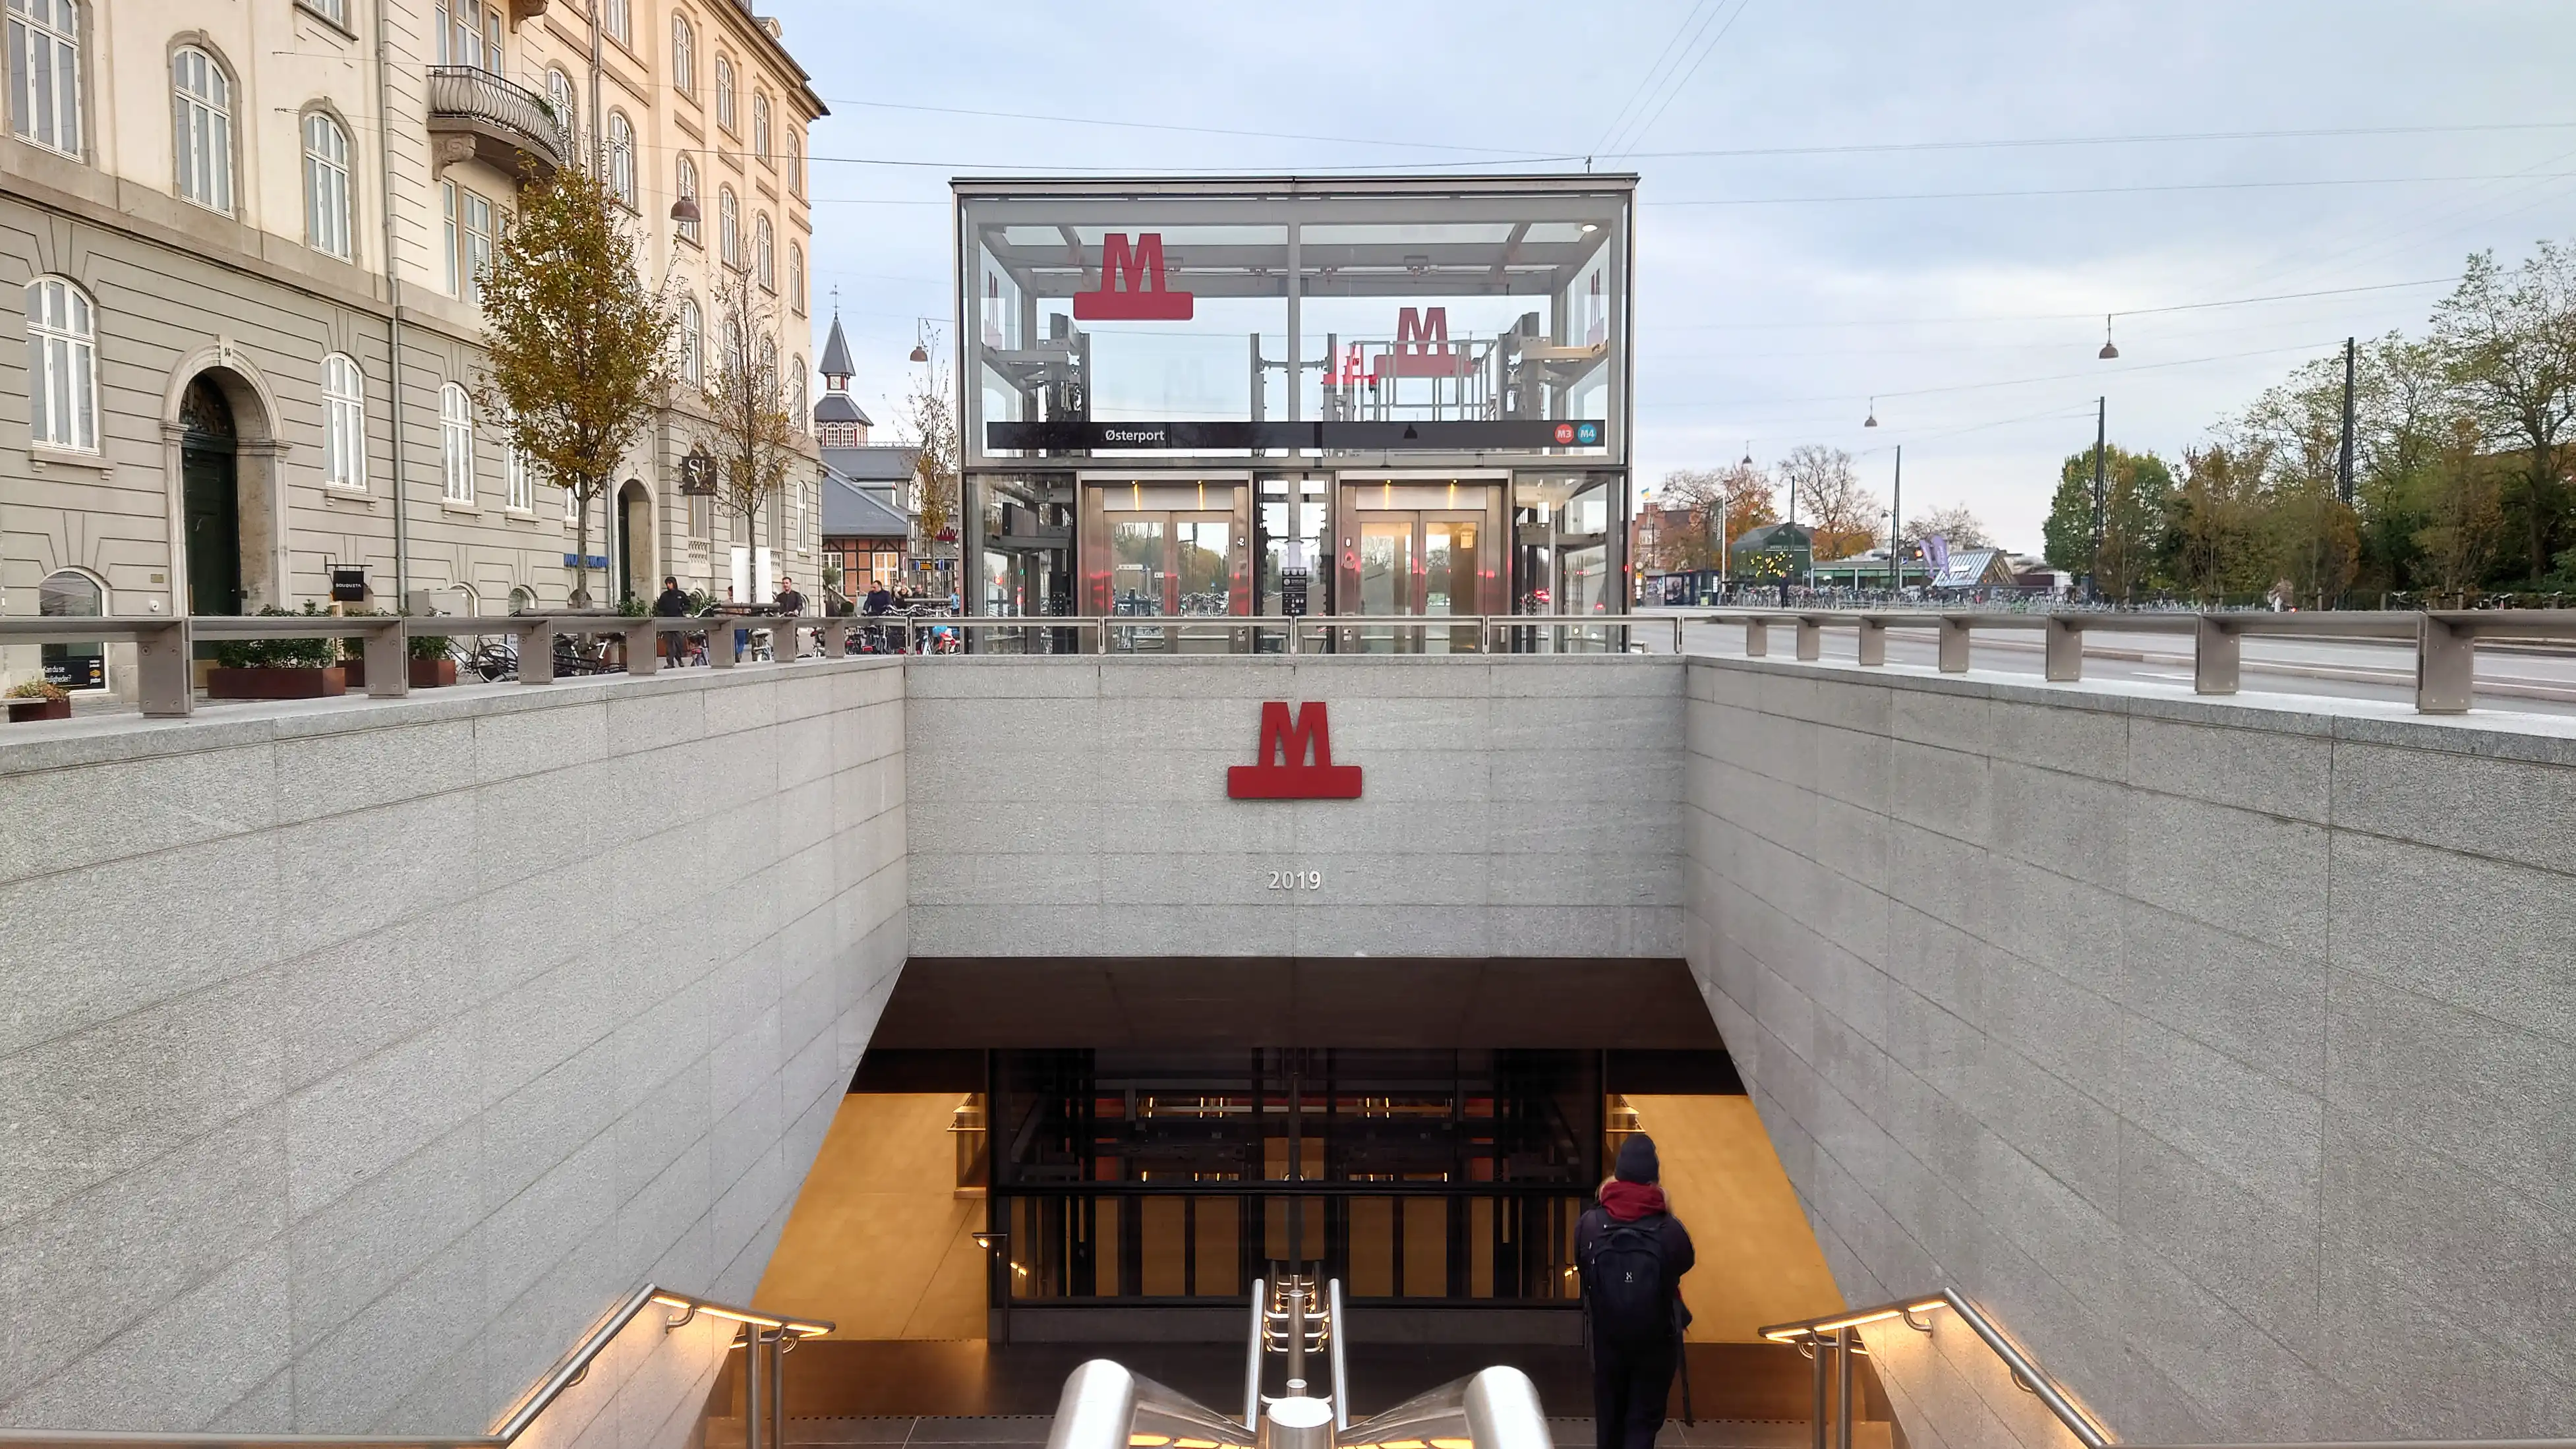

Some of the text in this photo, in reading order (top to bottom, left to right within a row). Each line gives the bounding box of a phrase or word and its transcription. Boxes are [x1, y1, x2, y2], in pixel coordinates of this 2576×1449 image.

[1105, 429, 1165, 443] Østerport
[1556, 429, 1595, 438] M3 M4
[1268, 870, 1322, 889] 2019
